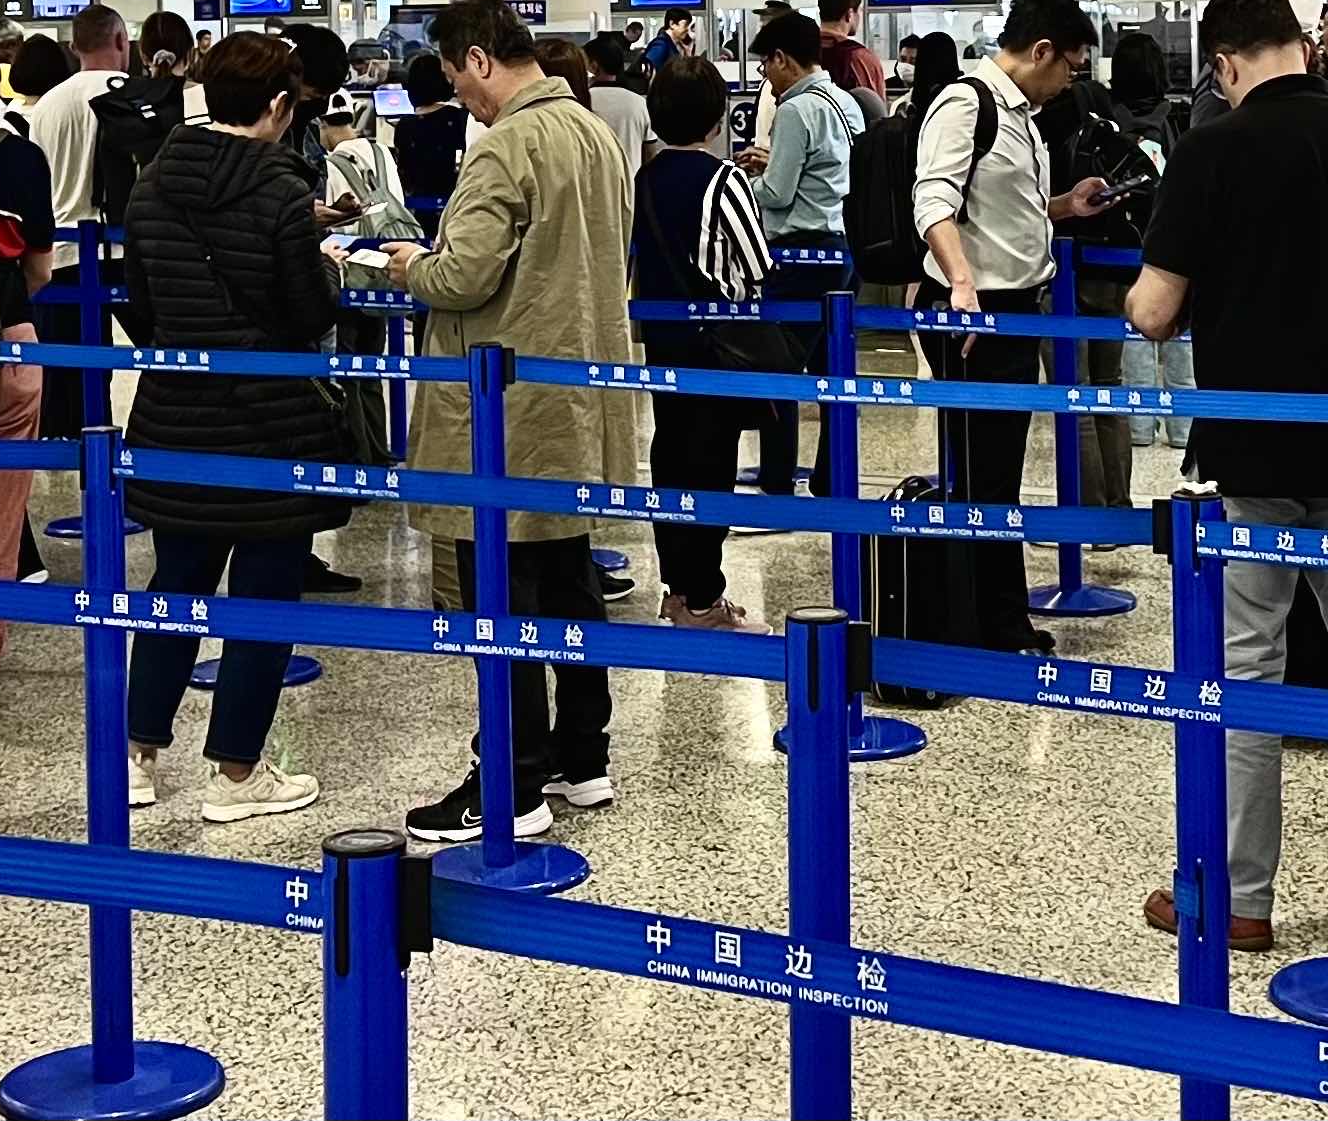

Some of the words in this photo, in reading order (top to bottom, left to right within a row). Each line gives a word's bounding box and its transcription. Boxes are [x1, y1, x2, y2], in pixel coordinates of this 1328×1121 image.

[734, 110, 752, 131] 3
[1068, 384, 1172, 406] 中国边检
[577, 485, 694, 510] 中国边检
[891, 504, 1022, 527] 中国边检
[75, 590, 208, 620] 中国边检
[433, 616, 583, 646] 中国边检
[434, 642, 461, 652] CHINA
[464, 645, 525, 656] IMMIGRATION
[529, 649, 584, 660] INSPECTION
[1038, 662, 1222, 706] 中国边检
[1037, 692, 1070, 704] CHINA
[1075, 697, 1148, 713] IMMIGRATION
[1153, 706, 1220, 722] INSPECTION
[647, 920, 887, 992] 中国边检
[648, 960, 690, 978] CHINA
[696, 969, 792, 997] IMMIGRATION
[798, 988, 888, 1014] INSPECTION
